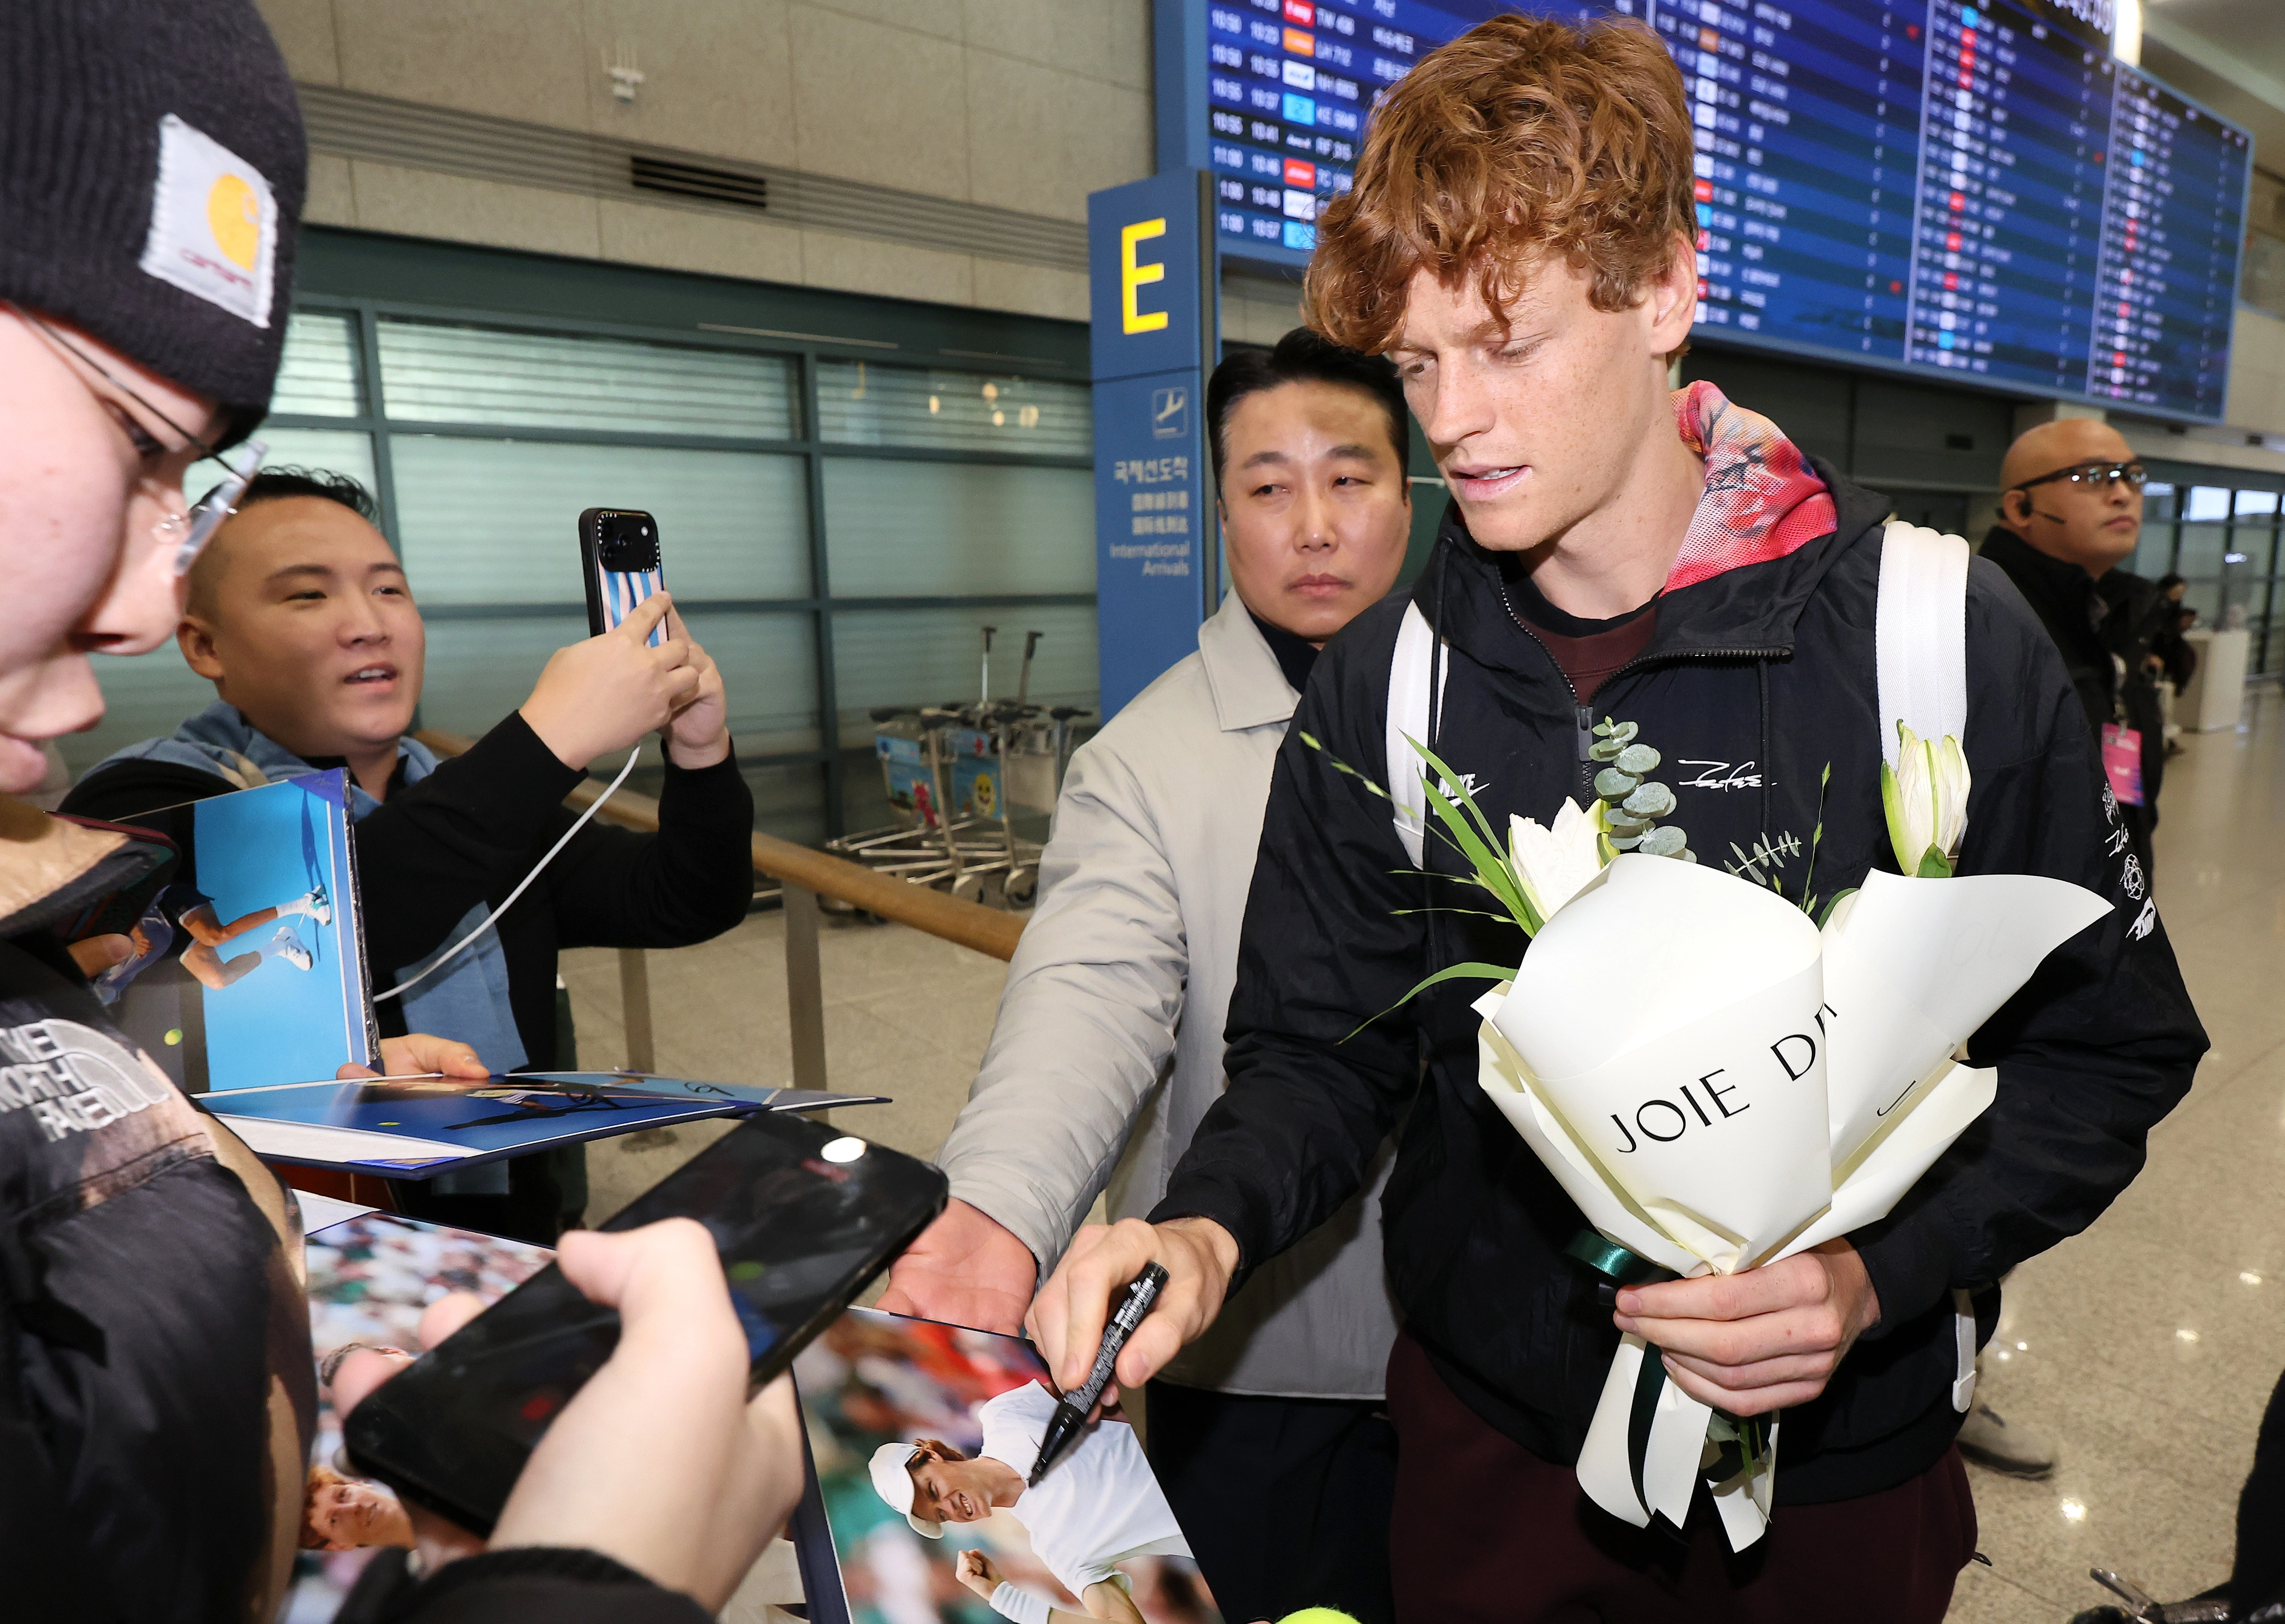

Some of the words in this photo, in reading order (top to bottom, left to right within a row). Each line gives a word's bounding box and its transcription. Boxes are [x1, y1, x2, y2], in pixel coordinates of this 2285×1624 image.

[1121, 218, 1169, 335] E
[1113, 456, 1188, 484] 국제선도착
[1109, 540, 1190, 559] International
[1142, 560, 1190, 577] Arrivals
[0, 1021, 63, 1064] HE
[1610, 1068, 1750, 1153] JOIE
